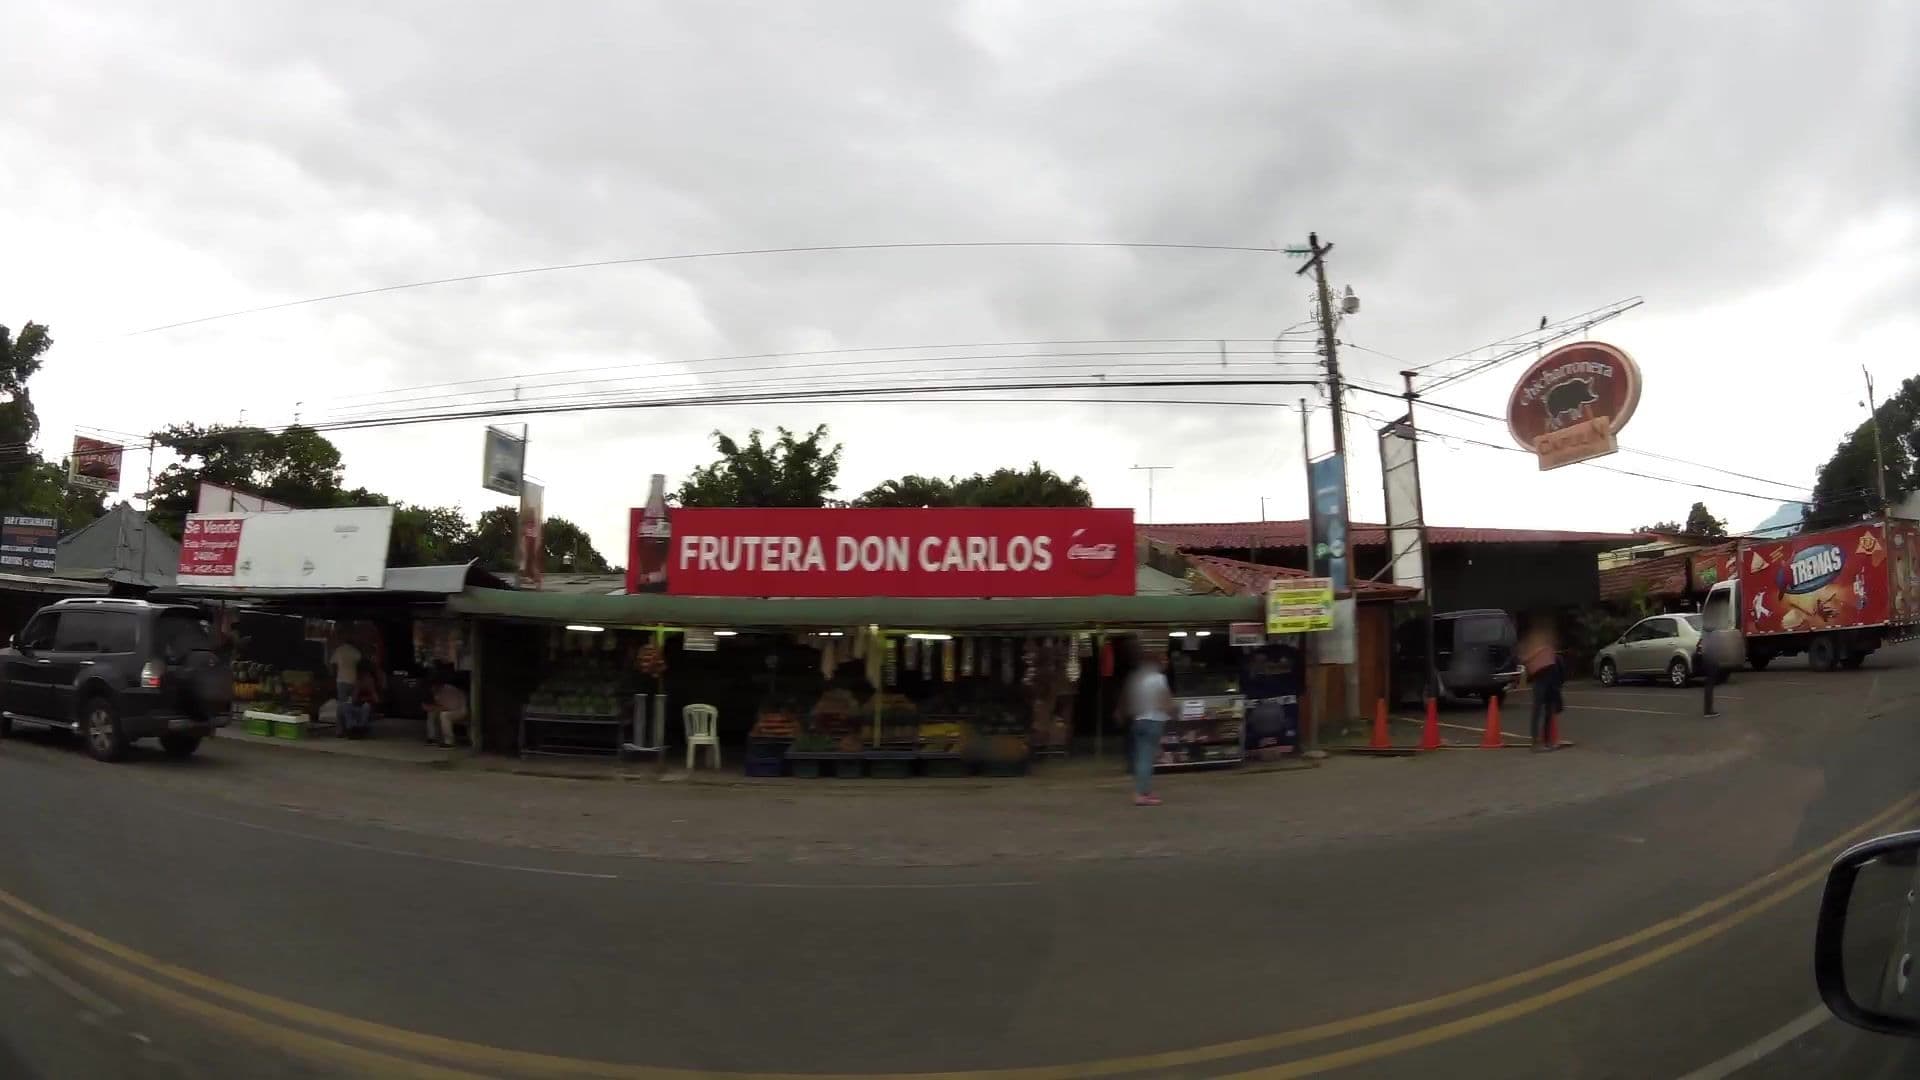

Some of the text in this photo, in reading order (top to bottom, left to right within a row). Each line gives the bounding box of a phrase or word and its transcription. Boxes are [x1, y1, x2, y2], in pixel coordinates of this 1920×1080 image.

[184, 520, 241, 534] Se Vende
[679, 536, 1053, 572] FRUTERA DON CARLOS
[1790, 546, 1843, 586] TREMAS
